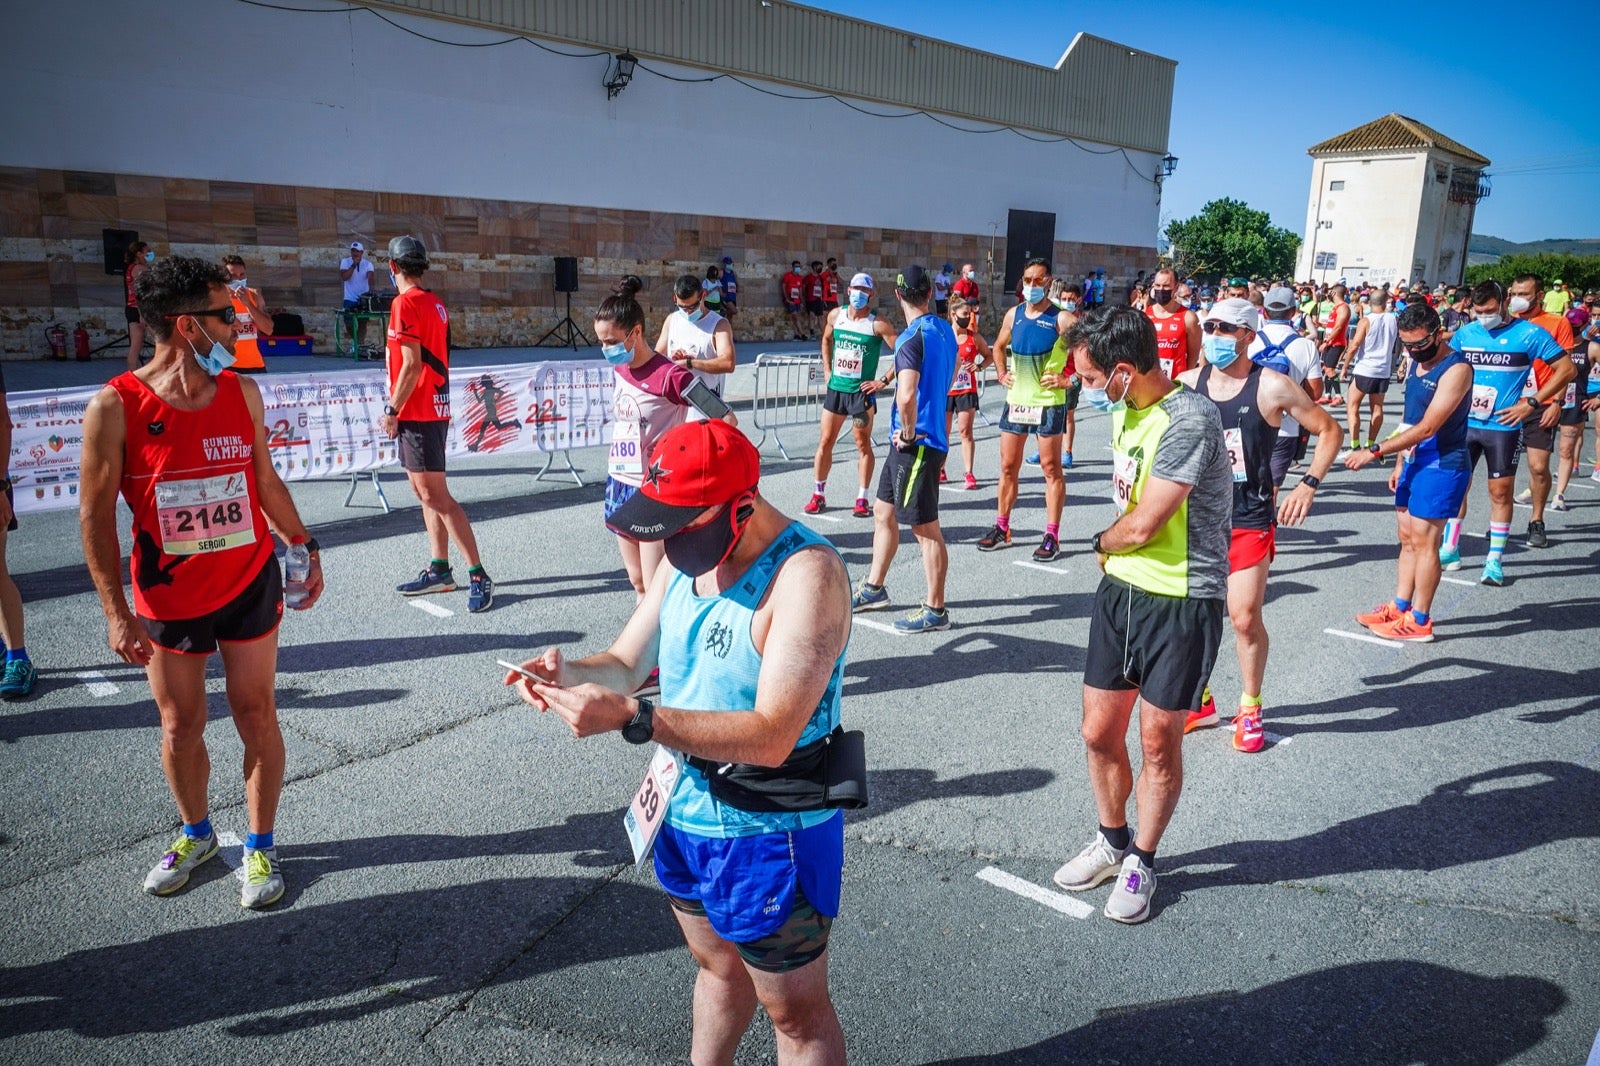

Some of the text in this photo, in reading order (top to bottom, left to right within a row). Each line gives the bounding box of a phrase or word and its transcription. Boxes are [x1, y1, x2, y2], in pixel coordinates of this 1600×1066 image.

[837, 359, 859, 370] 2067
[1473, 398, 1489, 409] 34
[203, 436, 243, 448] RUNNING
[175, 502, 243, 533] 2148
[630, 523, 666, 534] FOREVER
[198, 538, 226, 551] SERGIO
[639, 777, 660, 823] 39
